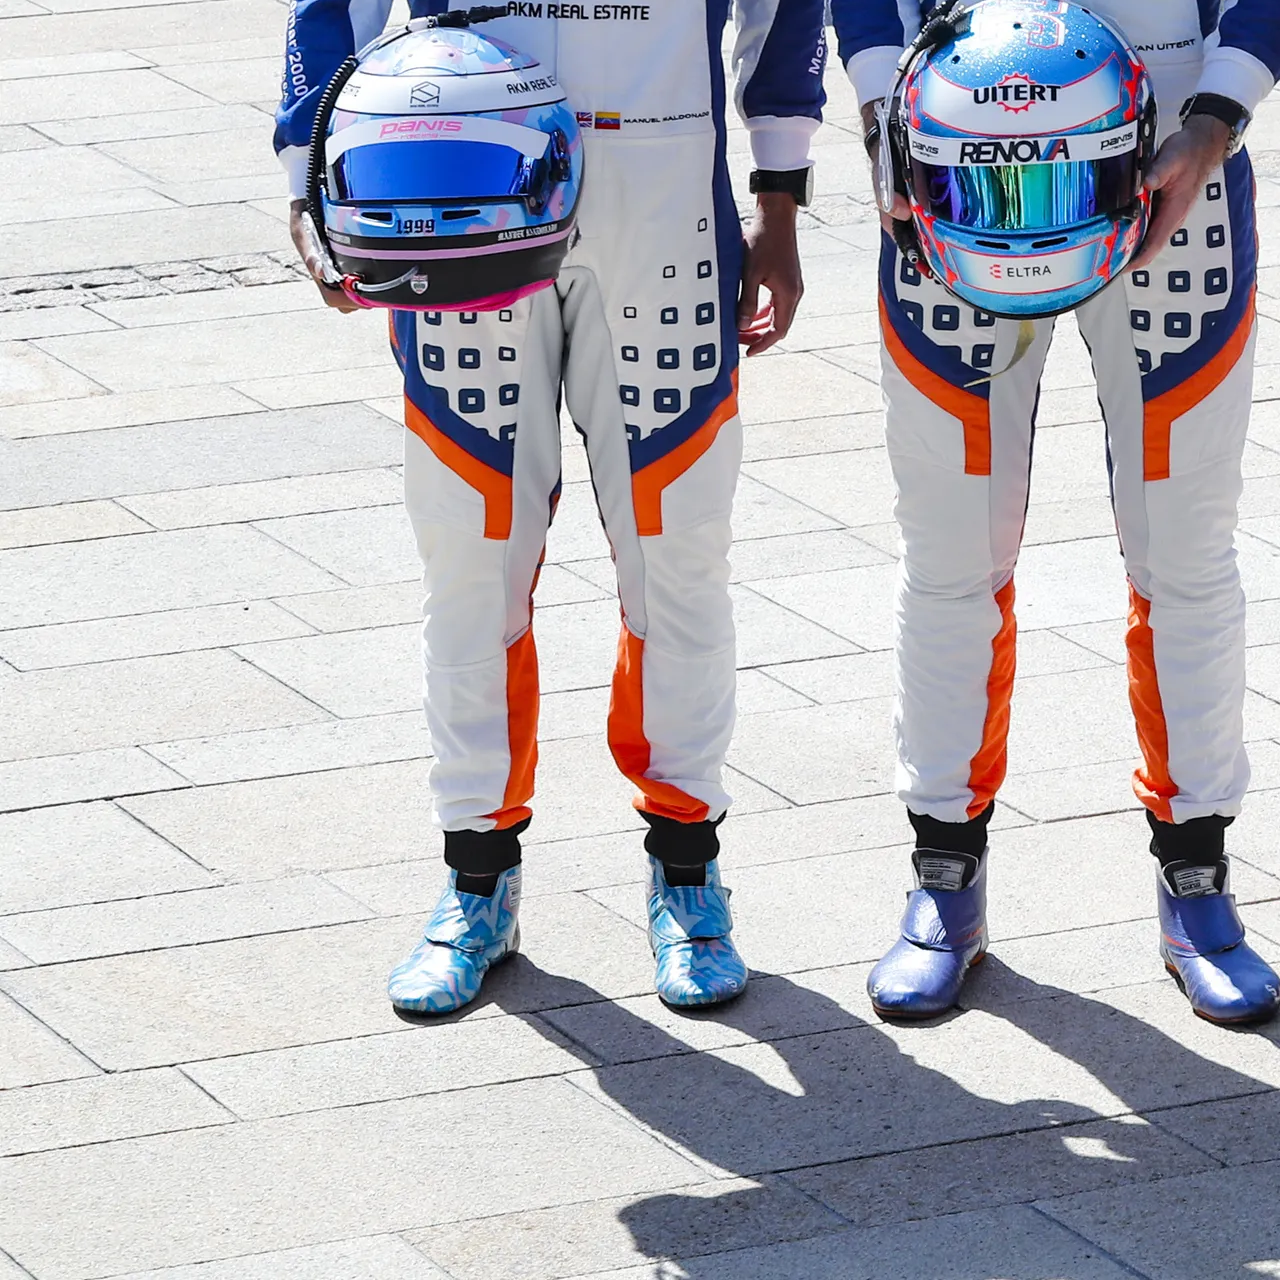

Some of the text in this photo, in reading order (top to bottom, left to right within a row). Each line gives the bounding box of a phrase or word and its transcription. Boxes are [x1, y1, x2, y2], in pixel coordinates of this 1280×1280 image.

[507, 1, 650, 21] AKM REAL ESTATE
[1157, 38, 1196, 51] UITERT
[288, 51, 309, 97] 2000
[506, 81, 530, 95] AKM
[531, 77, 551, 92] REAL
[973, 84, 1062, 105] UITERT
[959, 138, 1071, 164] RENOVA
[395, 219, 436, 234] 1999
[1006, 265, 1052, 278] ELTRA
